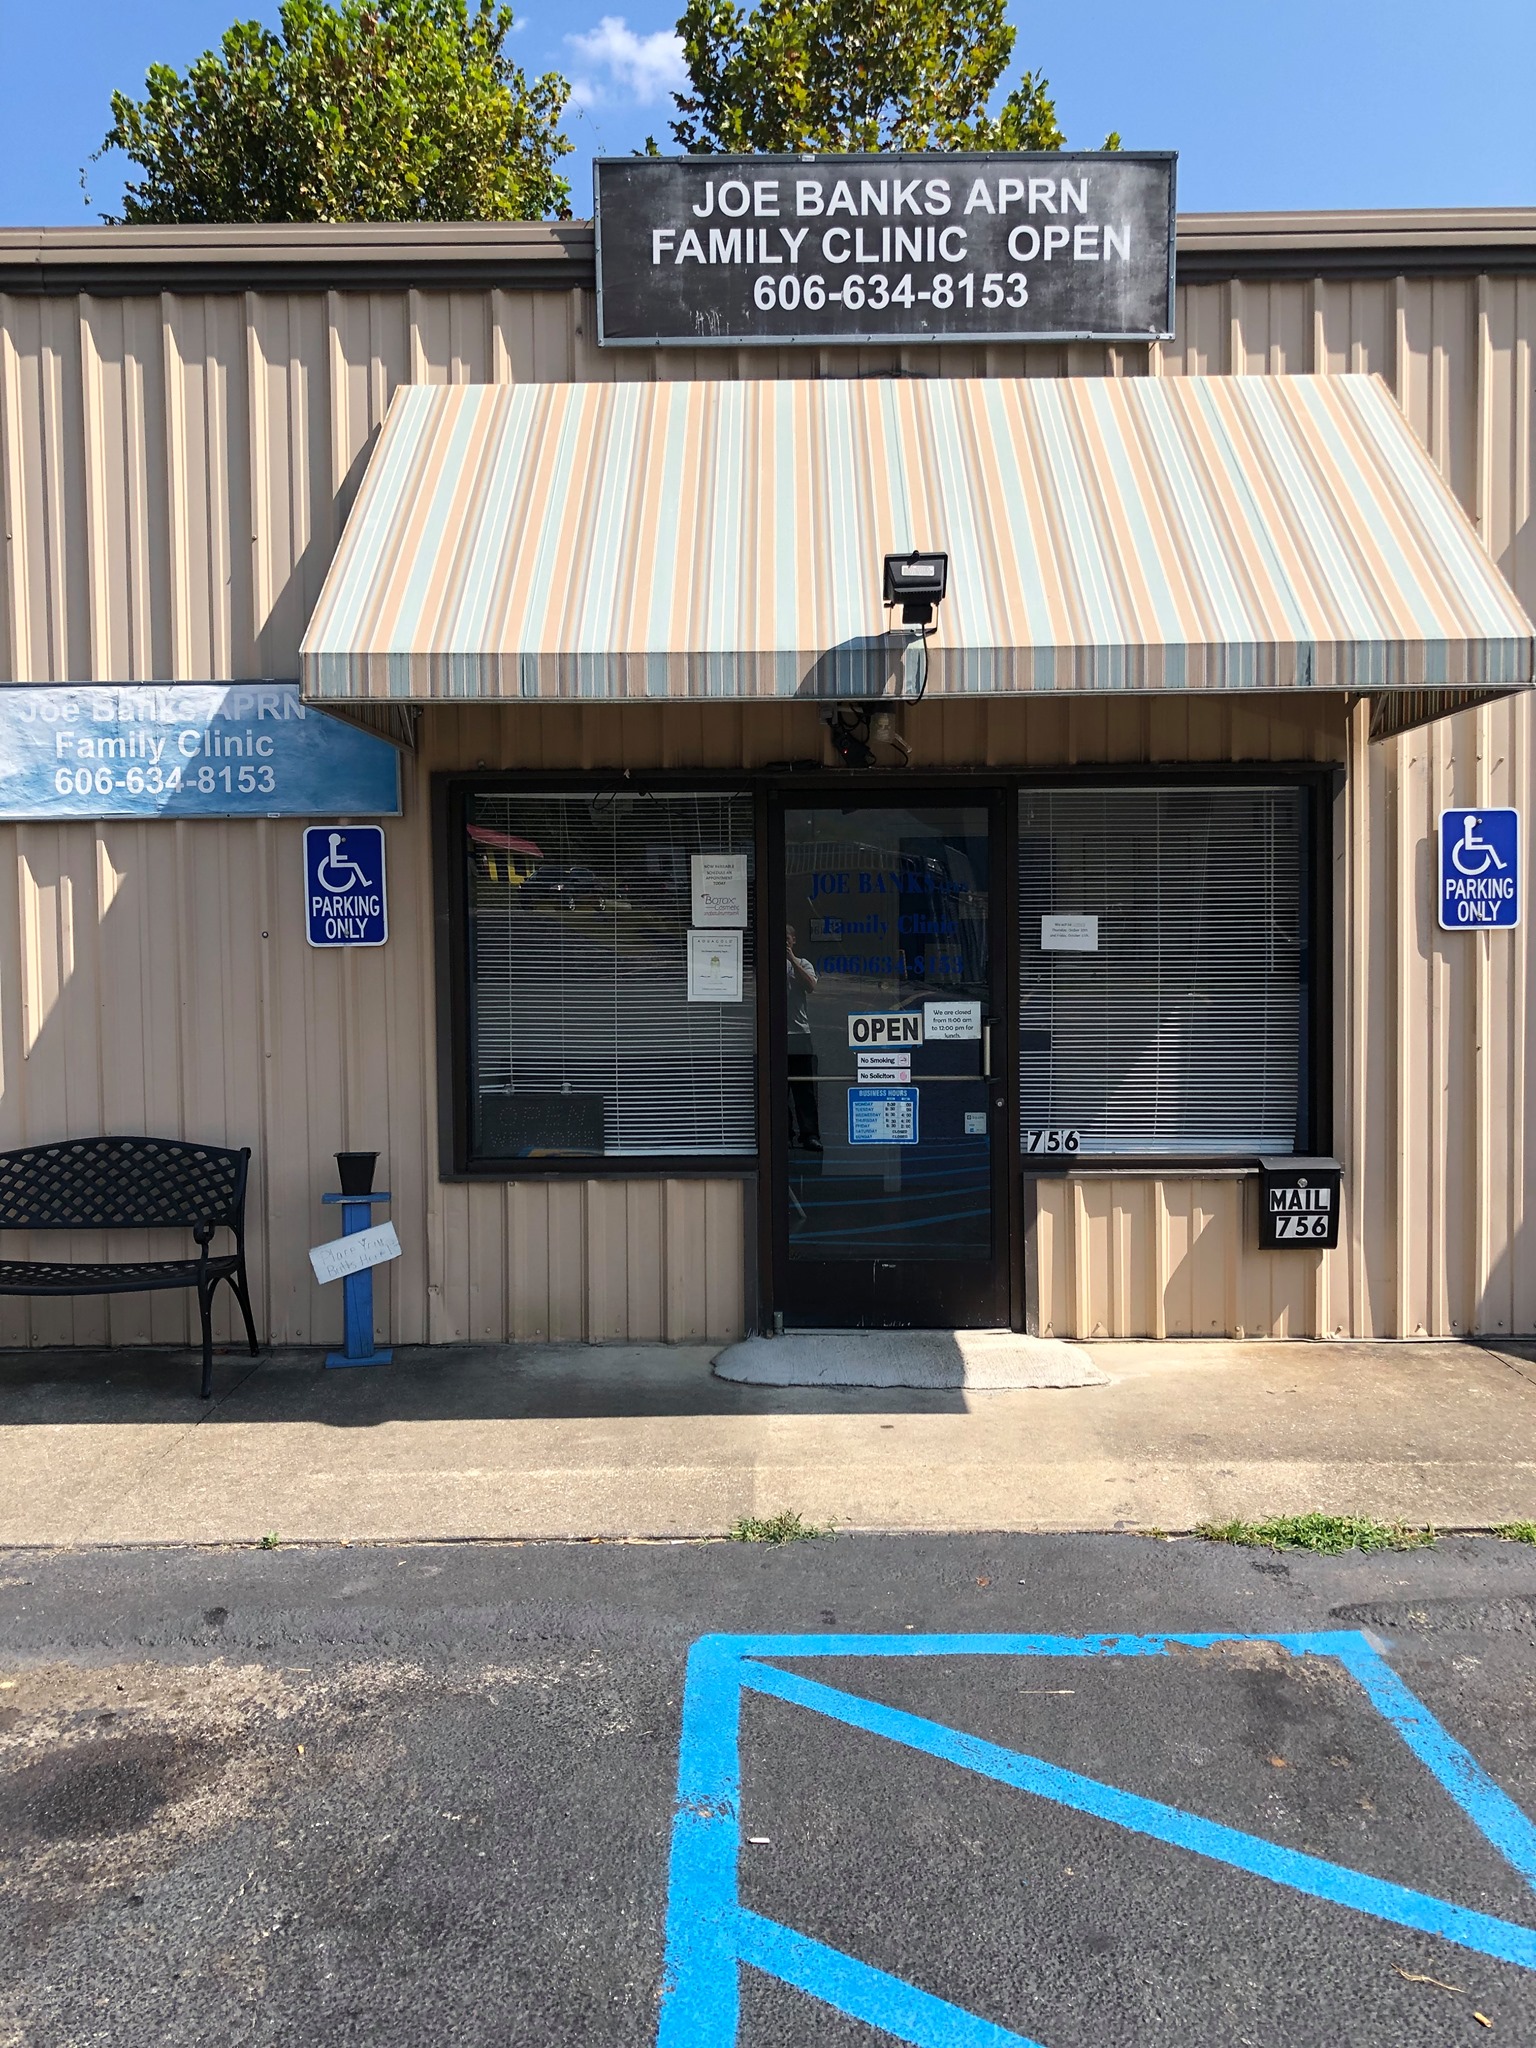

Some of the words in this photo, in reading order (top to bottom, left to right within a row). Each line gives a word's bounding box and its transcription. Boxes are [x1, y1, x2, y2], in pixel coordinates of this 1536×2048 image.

[692, 180, 779, 219] JOE
[796, 178, 952, 217] BANKS
[963, 177, 1089, 216] APRN
[652, 227, 809, 266] FAMILY
[821, 226, 968, 264] CLINIC
[1007, 224, 1131, 263] OPEN
[753, 272, 1029, 311] 606-634-8153
[20, 701, 80, 723] Joe
[92, 693, 196, 723] Banks
[205, 692, 306, 721] APRN
[55, 730, 166, 764] Family
[178, 729, 274, 758] Clinic
[55, 765, 276, 795] 606-634-8153
[810, 871, 850, 900] JOE
[859, 871, 934, 894] BANKS
[1445, 878, 1514, 900] PARKING
[312, 894, 380, 918] PARKING
[1457, 900, 1502, 922] ONLY
[325, 917, 369, 940] ONLY
[823, 914, 889, 940] Family
[897, 913, 959, 935] Clinic
[853, 1017, 918, 1042] OPEN
[1029, 1130, 1078, 1152] 756
[1270, 1190, 1328, 1210] MAIL
[1278, 1216, 1326, 1237] 756
